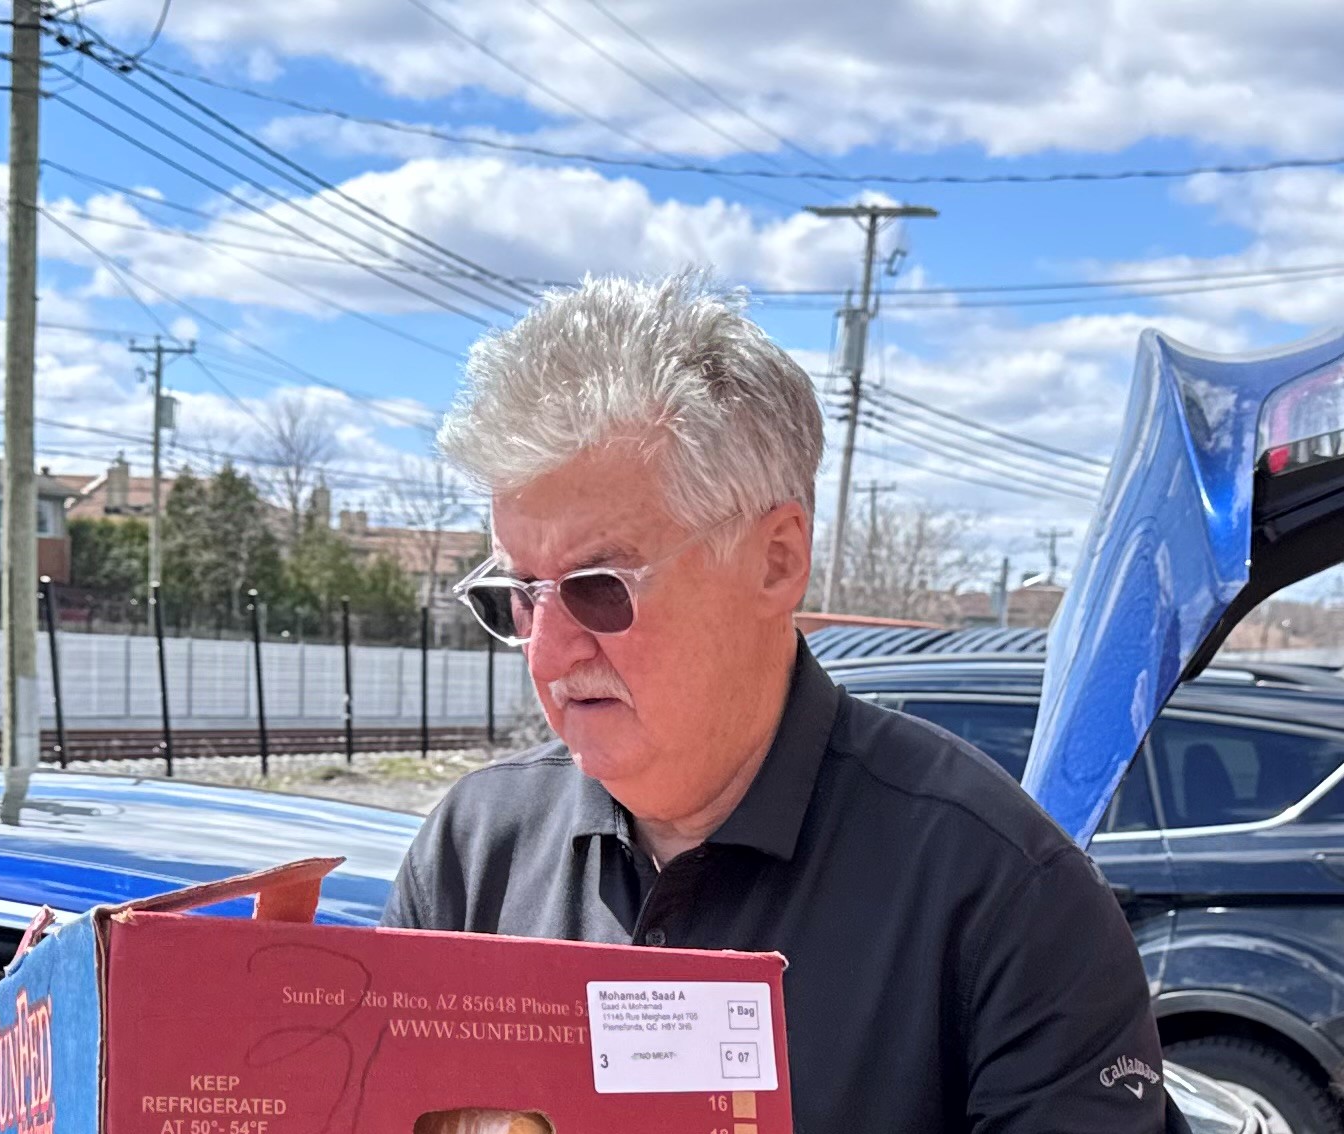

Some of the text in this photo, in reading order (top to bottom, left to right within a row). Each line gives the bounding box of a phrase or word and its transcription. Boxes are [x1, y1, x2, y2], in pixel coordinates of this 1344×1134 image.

[282, 986, 345, 1006] SunFed
[360, 991, 388, 1007] Rio
[392, 992, 431, 1011] Rico,
[435, 994, 457, 1011] AZ
[462, 995, 516, 1014] 85648
[521, 998, 570, 1017] Phone
[599, 990, 686, 1001] Mohamad, Saad A
[737, 1005, 755, 1018] Bag
[389, 1019, 588, 1045] WWW.SUNFED.NET
[600, 1053, 609, 1069] 3
[725, 1050, 750, 1063] C 07
[1099, 1055, 1160, 1087] Callaway
[190, 1075, 240, 1091] KEEP
[142, 1096, 287, 1115] REFRIGERATED
[708, 1095, 728, 1112] 16
